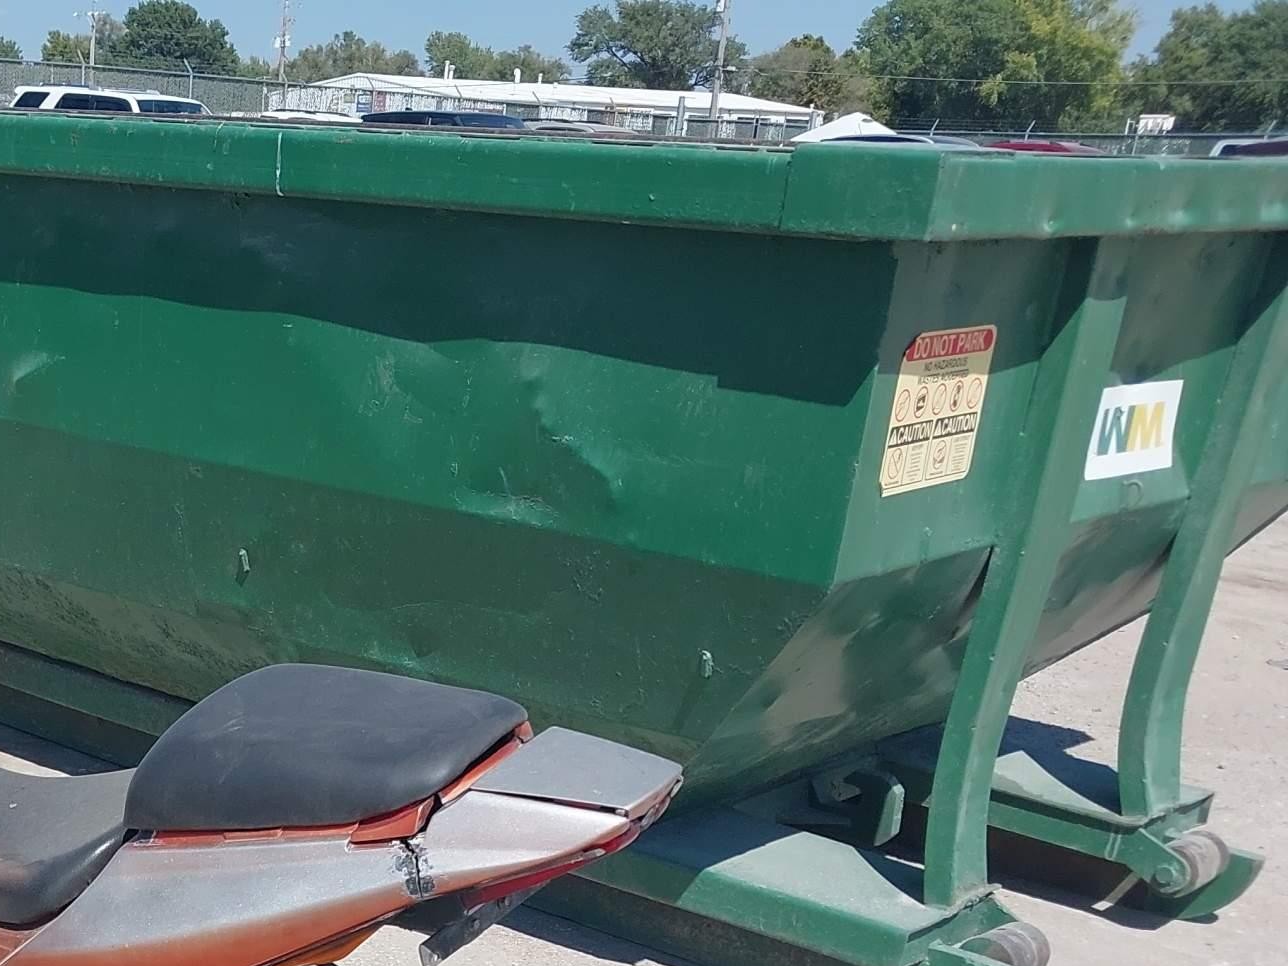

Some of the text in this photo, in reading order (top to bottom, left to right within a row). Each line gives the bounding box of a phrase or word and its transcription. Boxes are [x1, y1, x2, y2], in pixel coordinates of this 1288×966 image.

[913, 330, 988, 359] DO NOT PARK
[898, 420, 932, 444] CAUTION
[942, 413, 977, 435] CAUTION
[1097, 401, 1166, 456] WM
